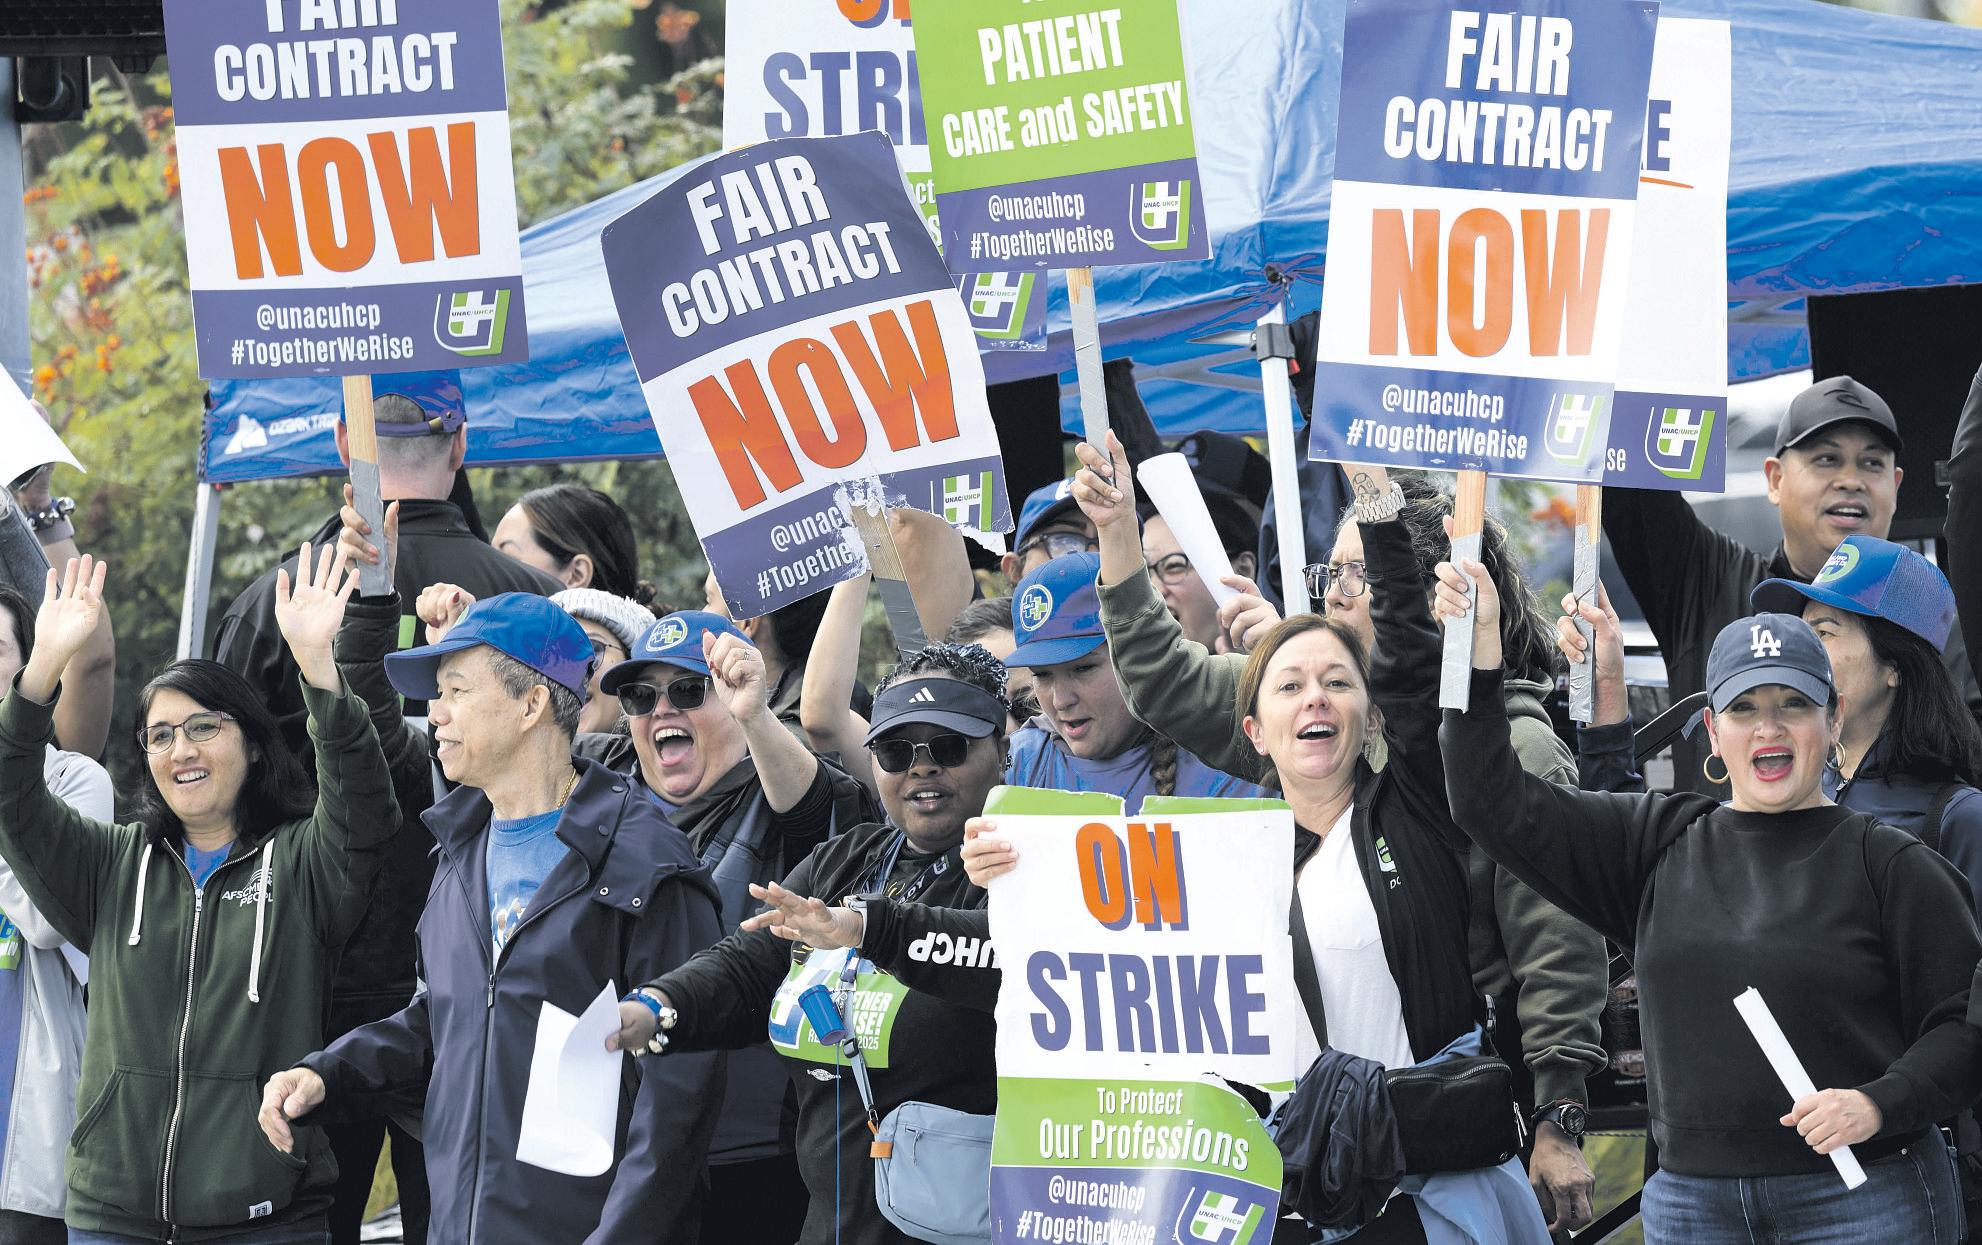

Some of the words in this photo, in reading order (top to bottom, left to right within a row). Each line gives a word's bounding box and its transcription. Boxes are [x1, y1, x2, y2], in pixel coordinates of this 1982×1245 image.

[214, 31, 457, 102] CONTRACT
[977, 9, 1125, 86] PATIENT
[1445, 10, 1573, 96] FAIR
[762, 50, 928, 146] STRI
[942, 106, 1014, 158] CARE
[1018, 96, 1078, 148] and
[1082, 80, 1184, 138] SAFETY
[1383, 95, 1613, 172] CONTRACT
[217, 121, 480, 280] NOW
[686, 155, 831, 256] FAIR
[988, 192, 1085, 222] @unacuhcp
[970, 225, 1114, 260] #TogetherWeRise
[661, 221, 902, 339] CONTRACT
[1369, 207, 1611, 358] NOW
[256, 302, 381, 331] @unacuhcp
[231, 333, 414, 367] #TogetherWeRise
[687, 299, 960, 511] NOW
[1382, 384, 1504, 423] @unacuhcp
[1347, 418, 1528, 460] #TogetherWeRise
[1661, 427, 1699, 436] UNAC/UHCP
[945, 493, 981, 504] UNAC/UHCP
[770, 506, 844, 552] @unac
[757, 541, 853, 599] #Togethe
[1750, 624, 1782, 658] LA
[1076, 822, 1189, 932] ON
[1026, 950, 1271, 1056] STRIKE
[857, 1035, 879, 1050] 2025
[1096, 1087, 1116, 1114] To
[1120, 1087, 1183, 1115] Protect
[1039, 1118, 1084, 1159] Our
[1090, 1118, 1249, 1171] Professions
[1048, 1174, 1146, 1214] @unacuhcp
[1016, 1210, 1156, 1245] #TogetherWeRise
